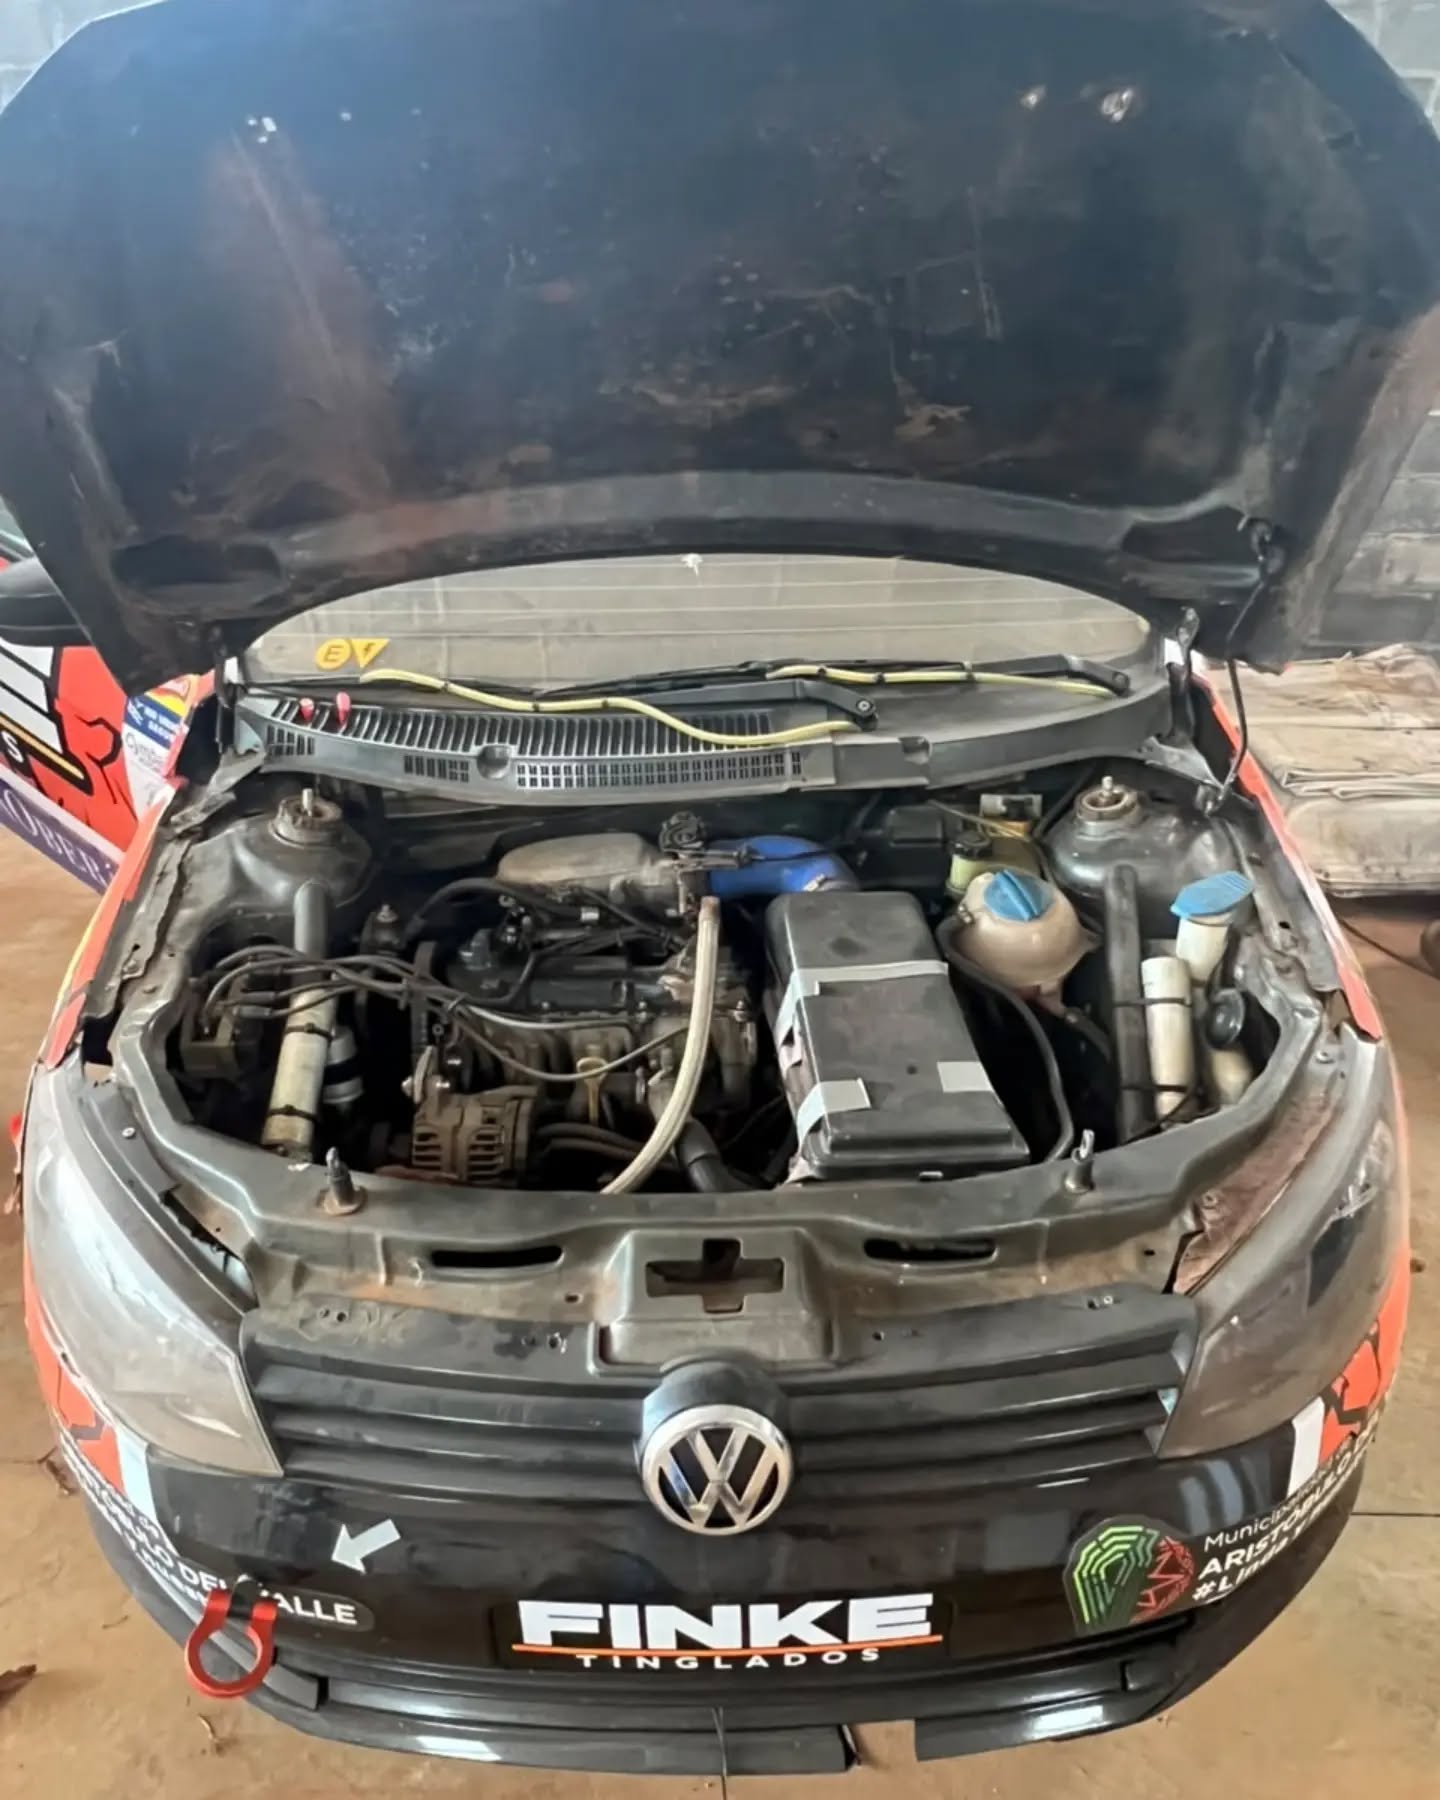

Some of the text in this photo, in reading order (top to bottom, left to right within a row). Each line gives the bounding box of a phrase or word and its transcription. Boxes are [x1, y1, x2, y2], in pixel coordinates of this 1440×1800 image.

[3, 788, 114, 890] OBER
[252, 1583, 358, 1626] ALLE
[517, 1592, 934, 1650] FINKE
[575, 1647, 880, 1671] TINGLADOS
